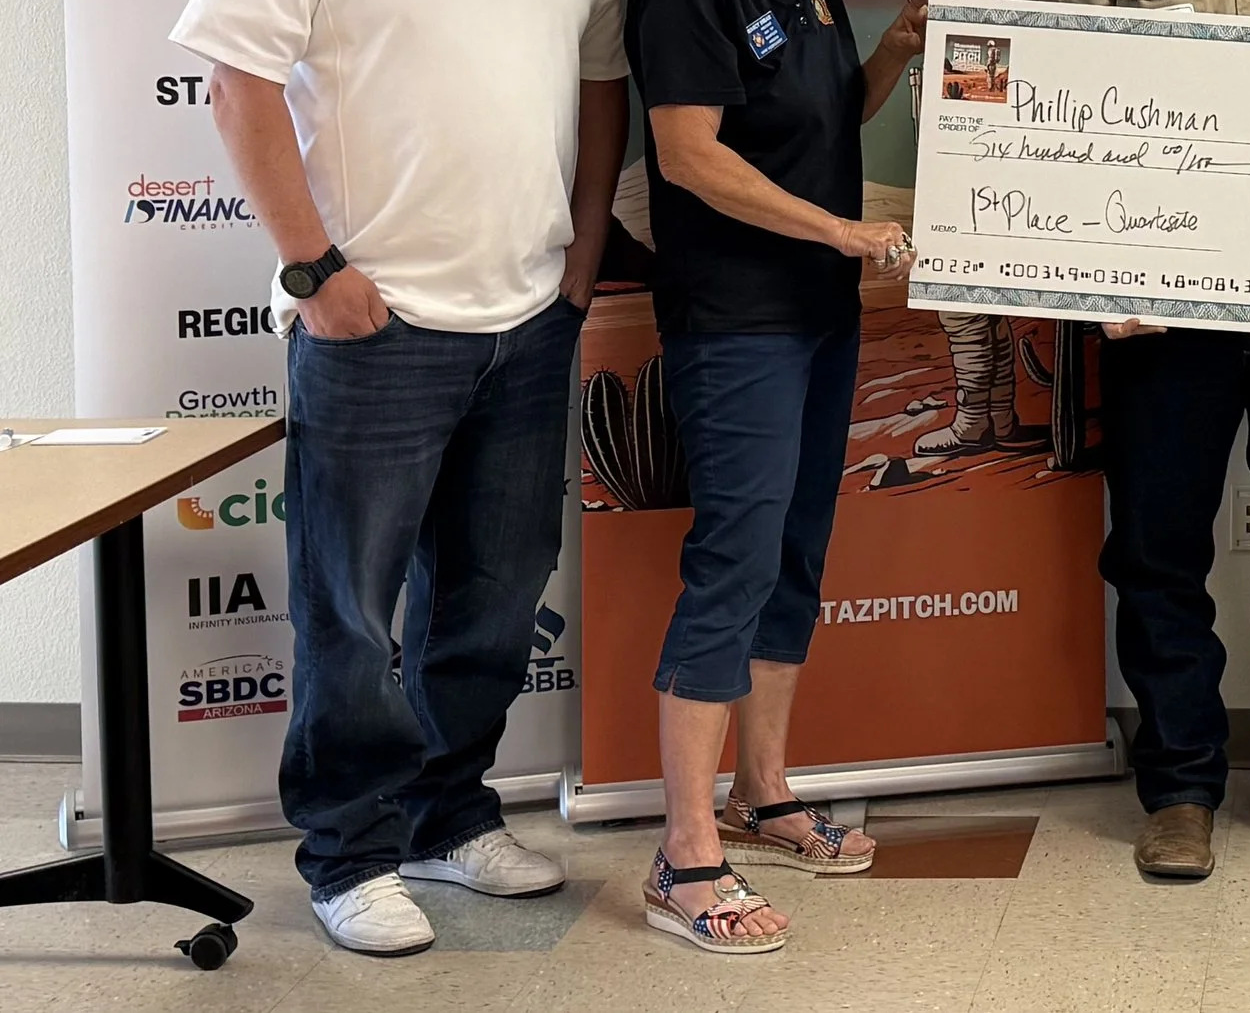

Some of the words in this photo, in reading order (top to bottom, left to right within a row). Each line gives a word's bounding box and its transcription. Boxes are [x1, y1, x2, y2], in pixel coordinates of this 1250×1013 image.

[156, 76, 211, 106] ST
[1006, 80, 1093, 131] Phillip
[1101, 86, 1219, 131] Cushman
[938, 115, 954, 123] PAY
[956, 116, 966, 124] TO
[969, 131, 1013, 161] Six
[1102, 141, 1149, 167] and
[128, 174, 215, 197] desert
[150, 197, 256, 223] FINANC
[1002, 189, 1073, 233] Place
[930, 224, 957, 233] MEMO
[178, 305, 277, 339] REGIO
[179, 385, 277, 411] Growth
[188, 572, 267, 617] IIA
[820, 589, 1019, 625] TAZPITCH.COM
[188, 618, 232, 630] INFINITY
[178, 672, 286, 707] SBDC
[203, 703, 263, 719] ARIZONA
